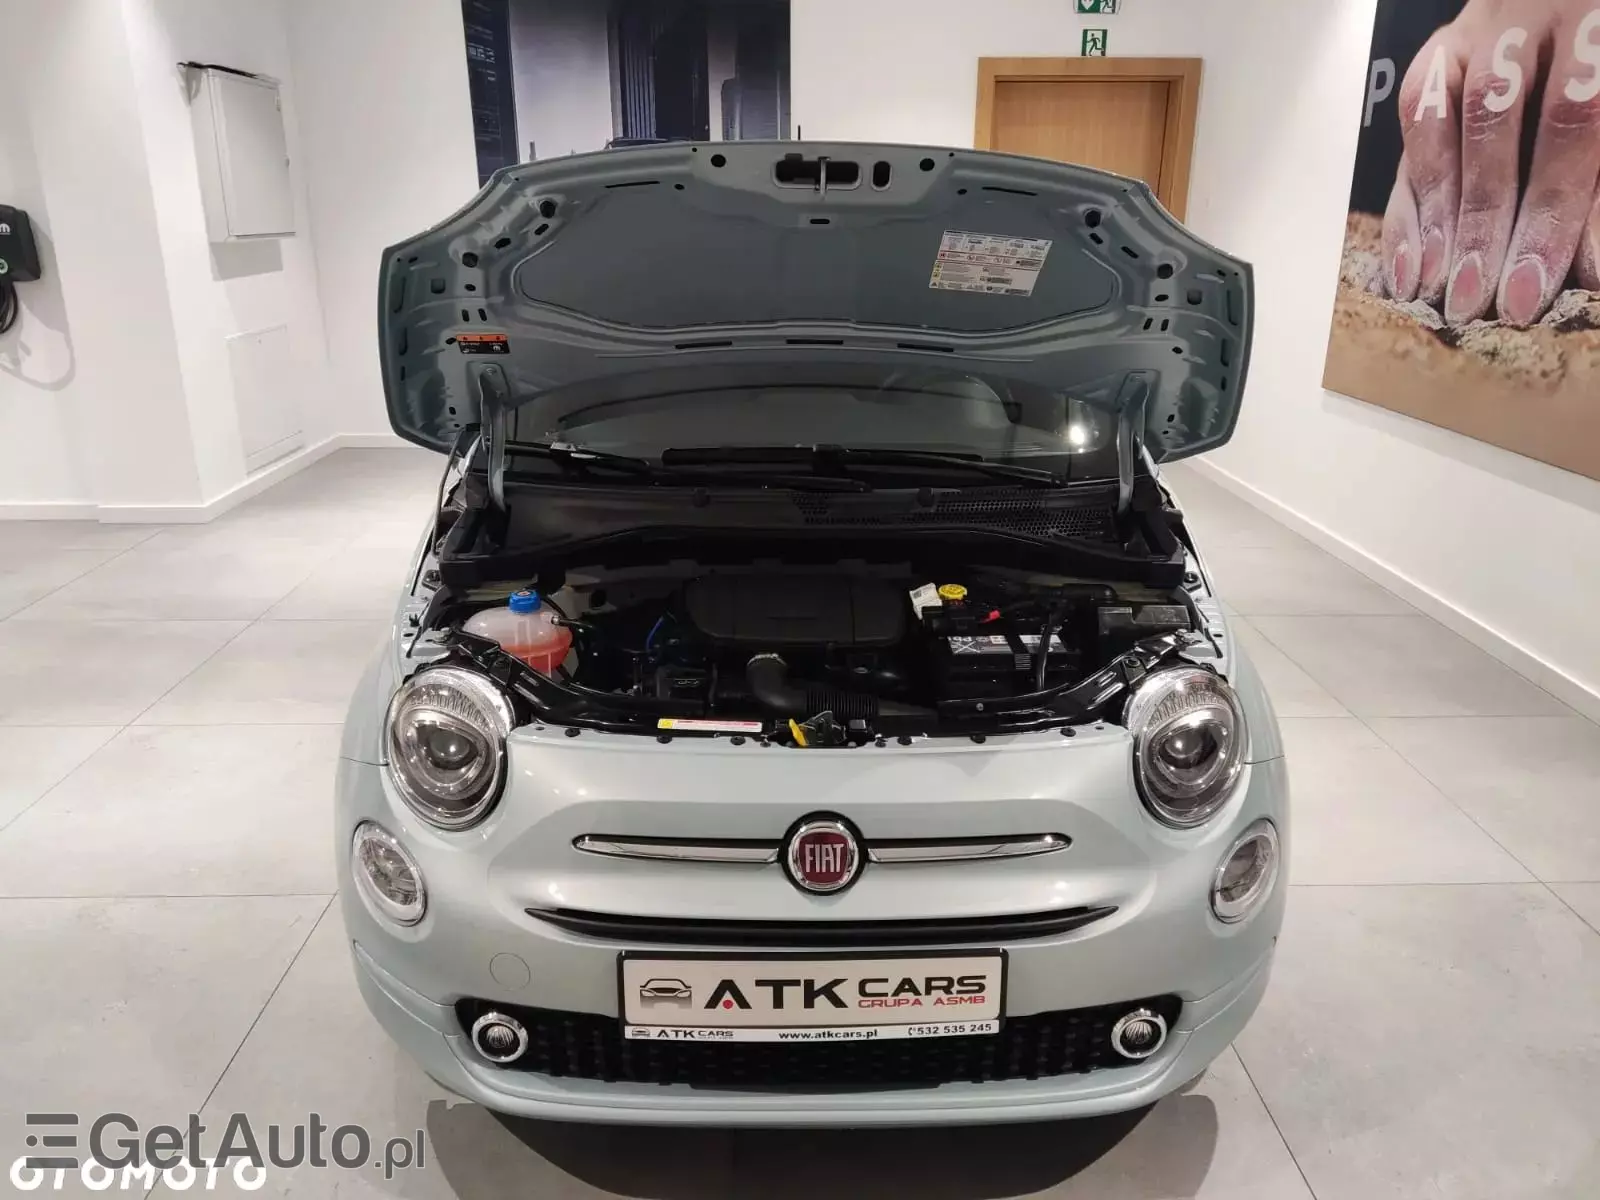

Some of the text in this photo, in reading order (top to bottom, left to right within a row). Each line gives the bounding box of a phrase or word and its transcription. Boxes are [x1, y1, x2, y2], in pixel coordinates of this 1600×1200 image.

[804, 843, 845, 873] FIAT
[704, 975, 987, 1009] ATK CARS
[858, 995, 986, 1009] GRUPA ASMB
[657, 1029, 695, 1039] ATK
[778, 1029, 878, 1039] www.atkcars.pl
[917, 1026, 939, 1035] 532
[943, 1025, 966, 1033] 535
[970, 1023, 992, 1032] 245
